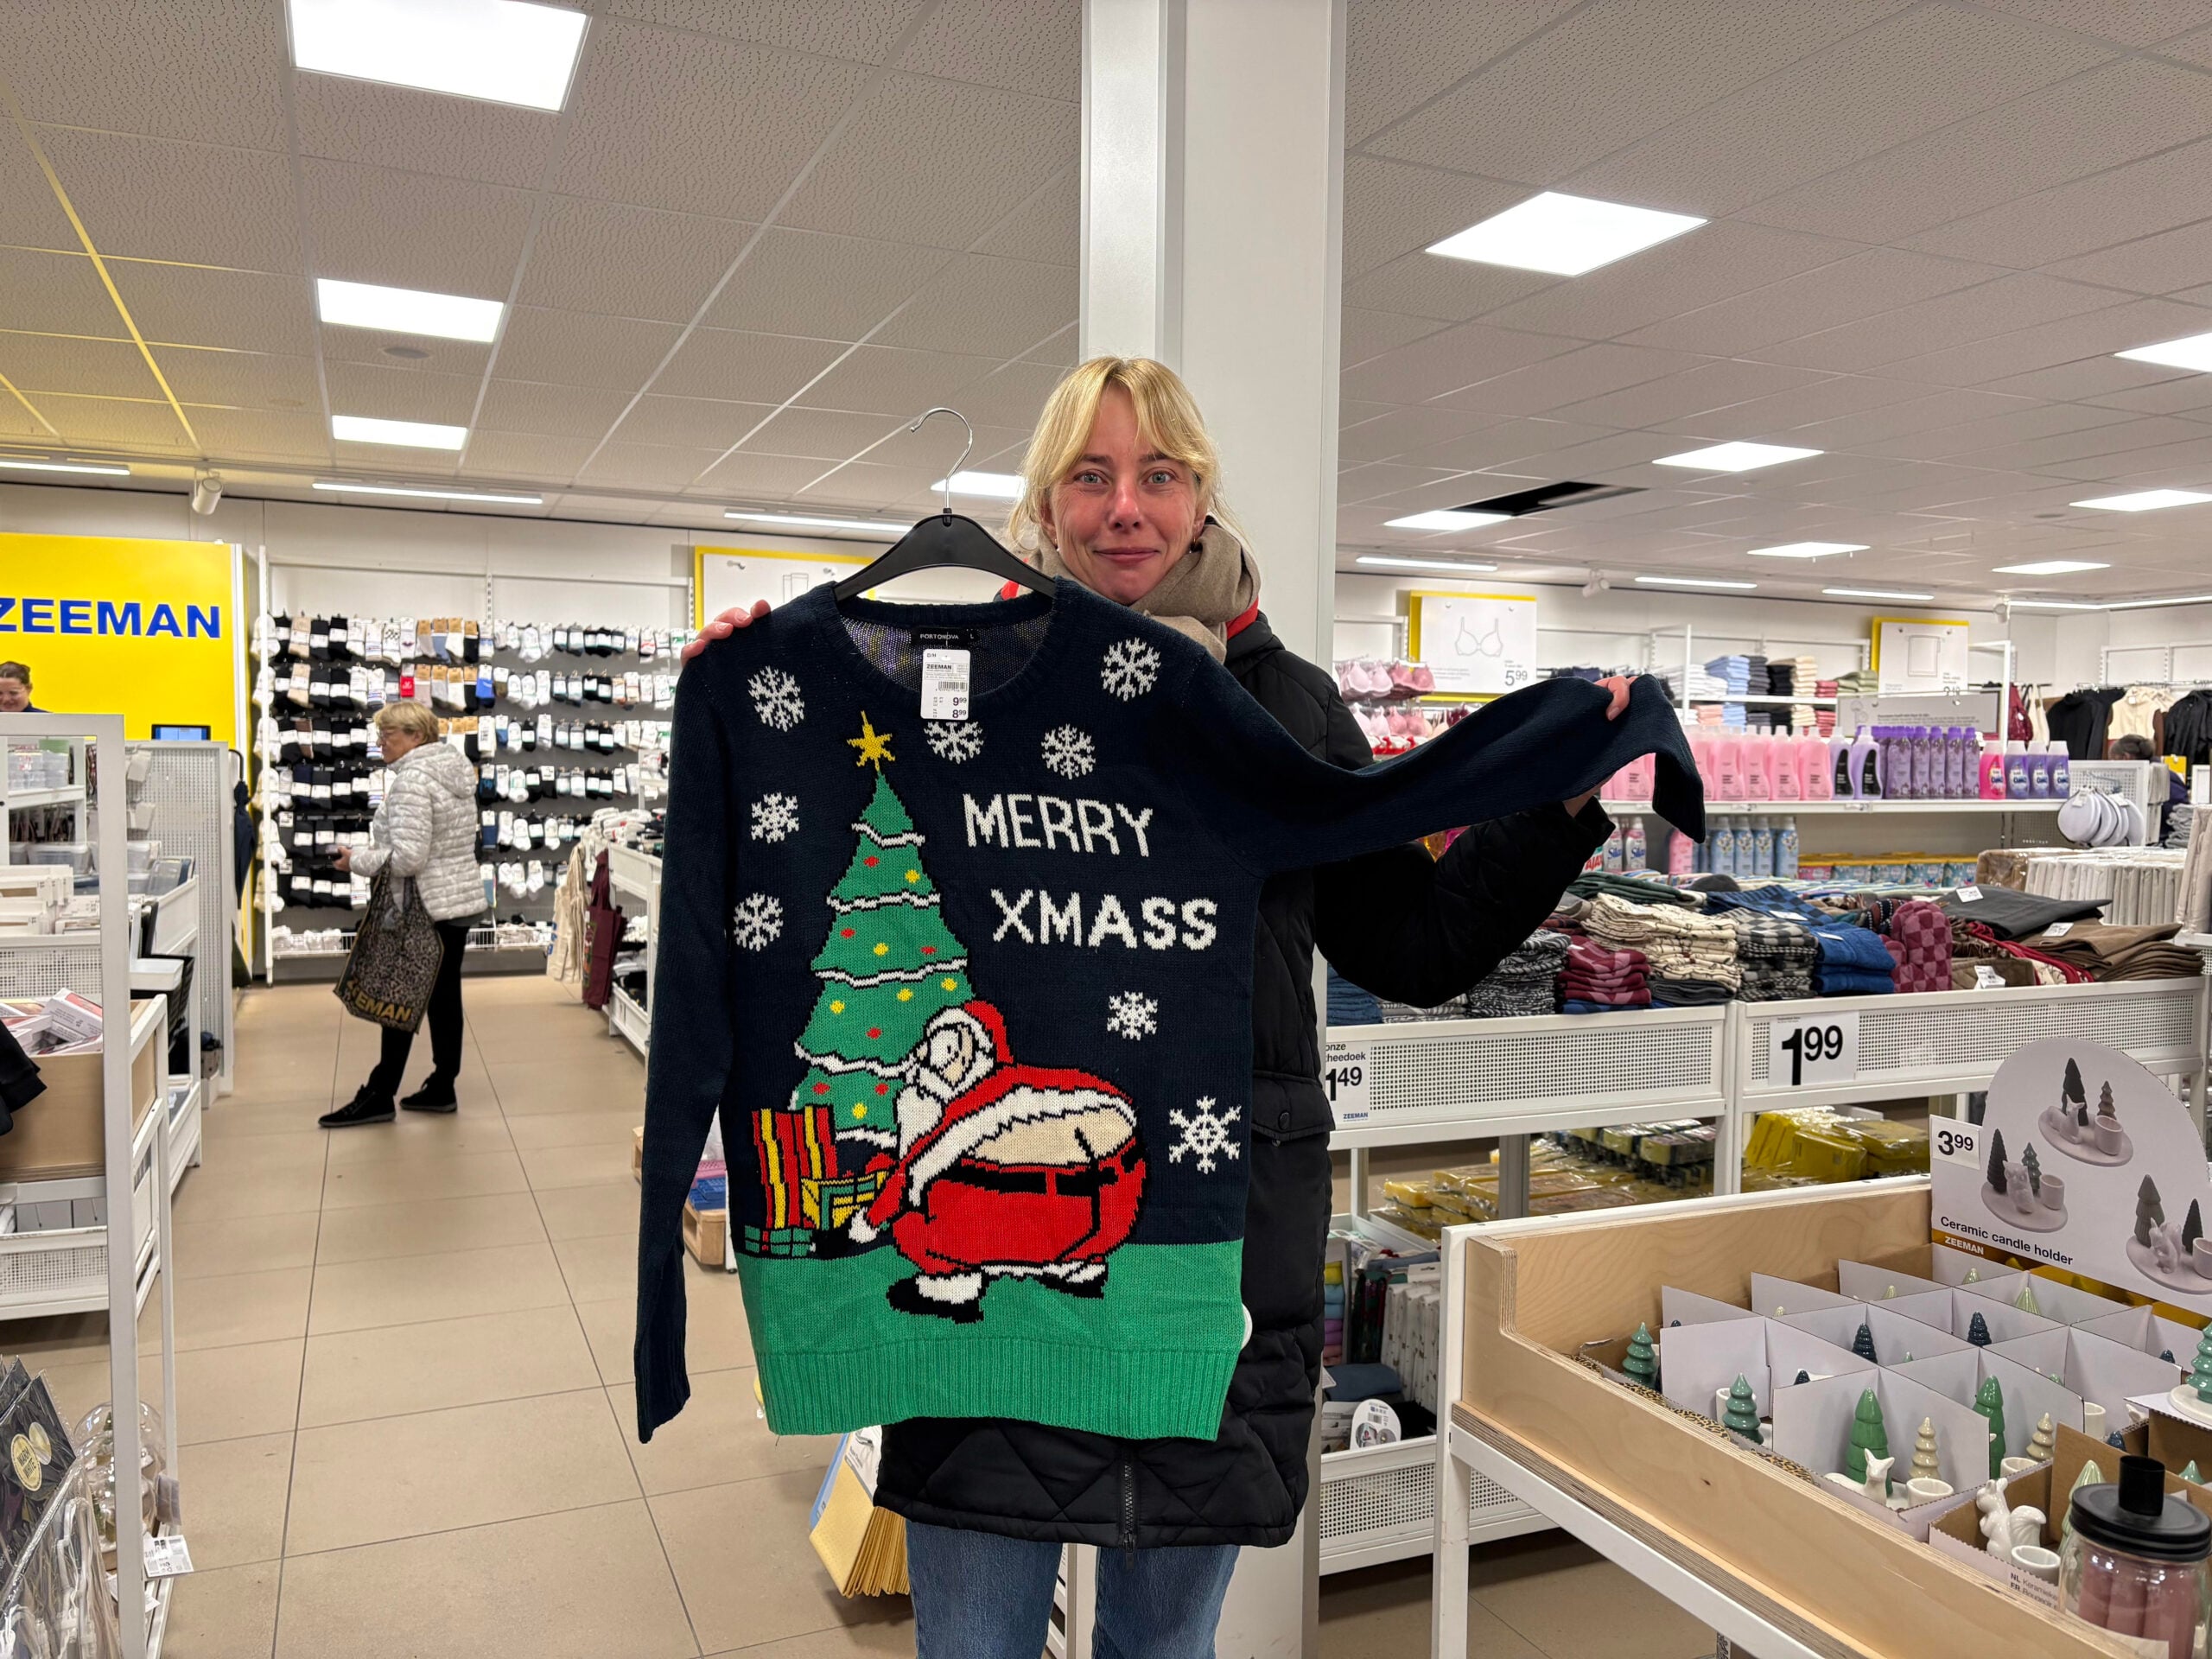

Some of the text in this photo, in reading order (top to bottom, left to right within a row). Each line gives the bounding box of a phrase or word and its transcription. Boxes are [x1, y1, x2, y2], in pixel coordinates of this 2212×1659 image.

[963, 793, 1154, 857] MERRY
[990, 888, 1218, 950] XMASS
[1941, 1216, 2073, 1265] Ceramic candle holder
[1945, 1236, 1984, 1255] ZEEMAN
[2011, 1573, 2020, 1583] NL
